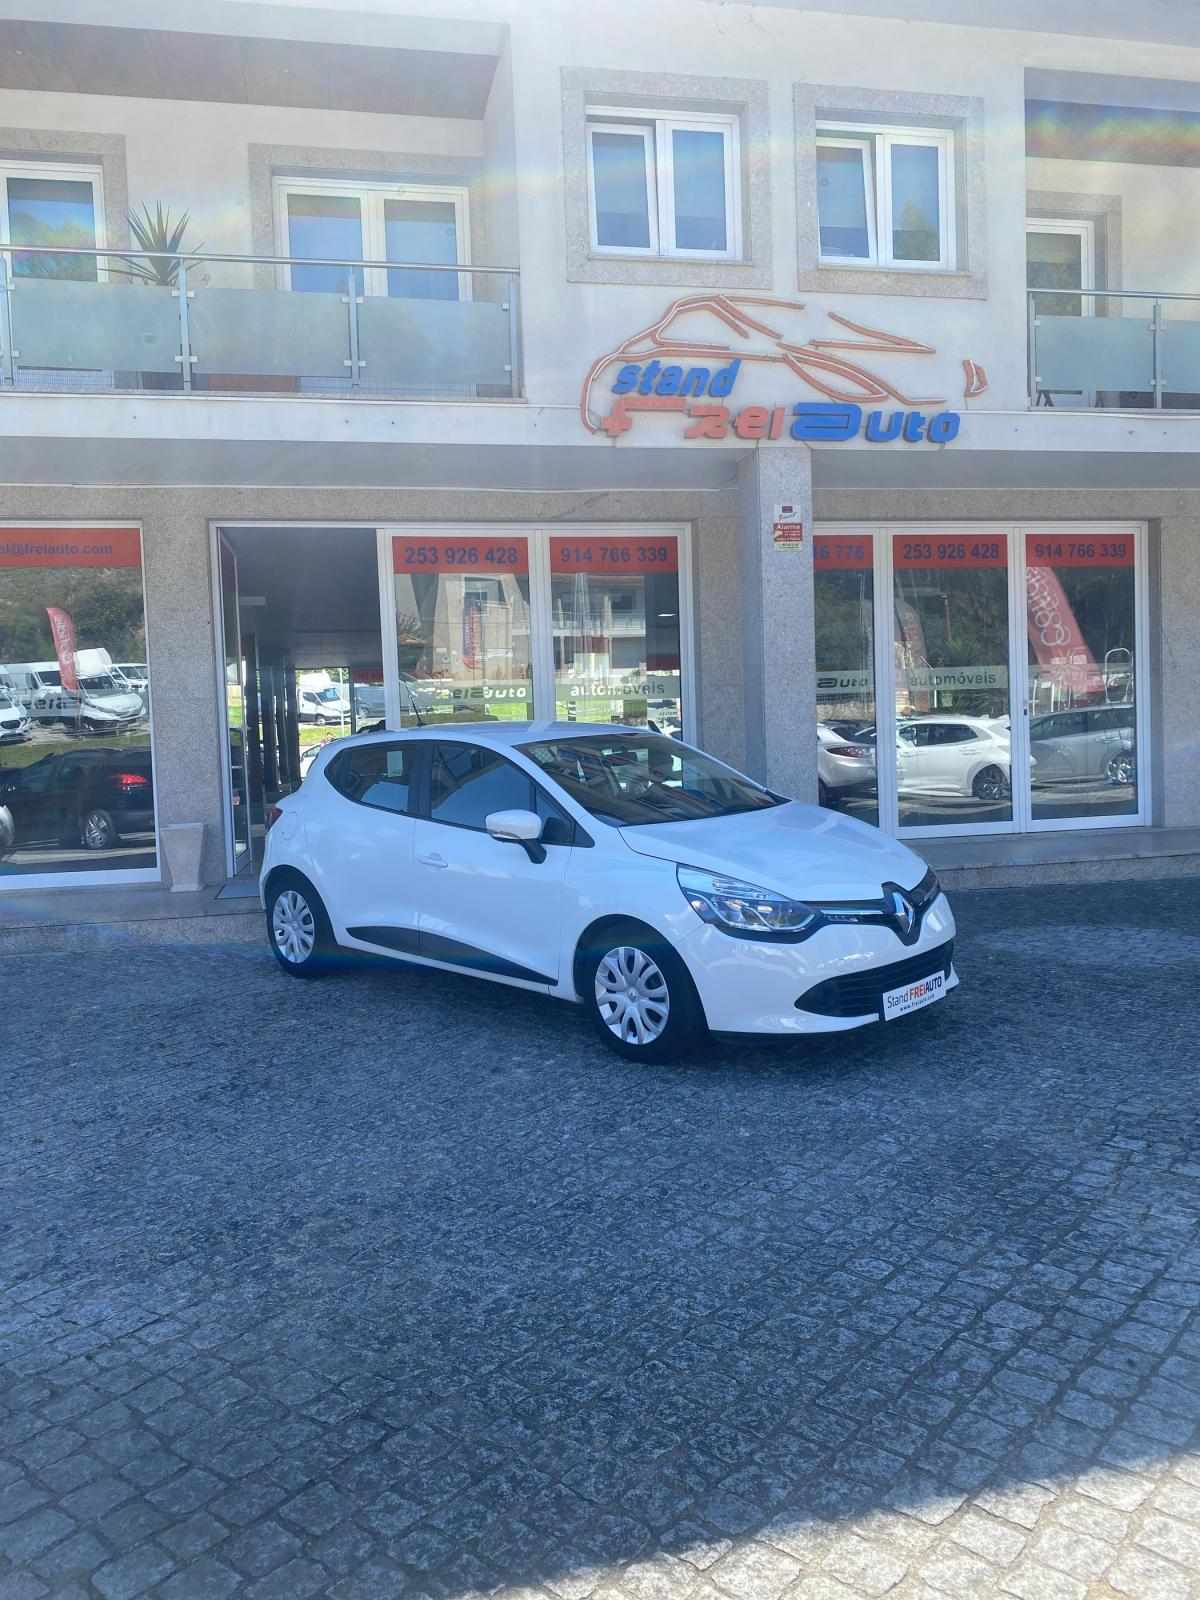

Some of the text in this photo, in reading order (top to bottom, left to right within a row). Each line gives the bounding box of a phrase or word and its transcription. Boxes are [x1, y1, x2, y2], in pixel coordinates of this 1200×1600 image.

[611, 359, 741, 397] stand
[405, 546, 518, 564] 253 926 428
[560, 545, 668, 563] 914 766 339
[904, 543, 999, 560] 253 926 428
[1035, 543, 1126, 560] 914 766 339
[887, 990, 908, 1008] Stand
